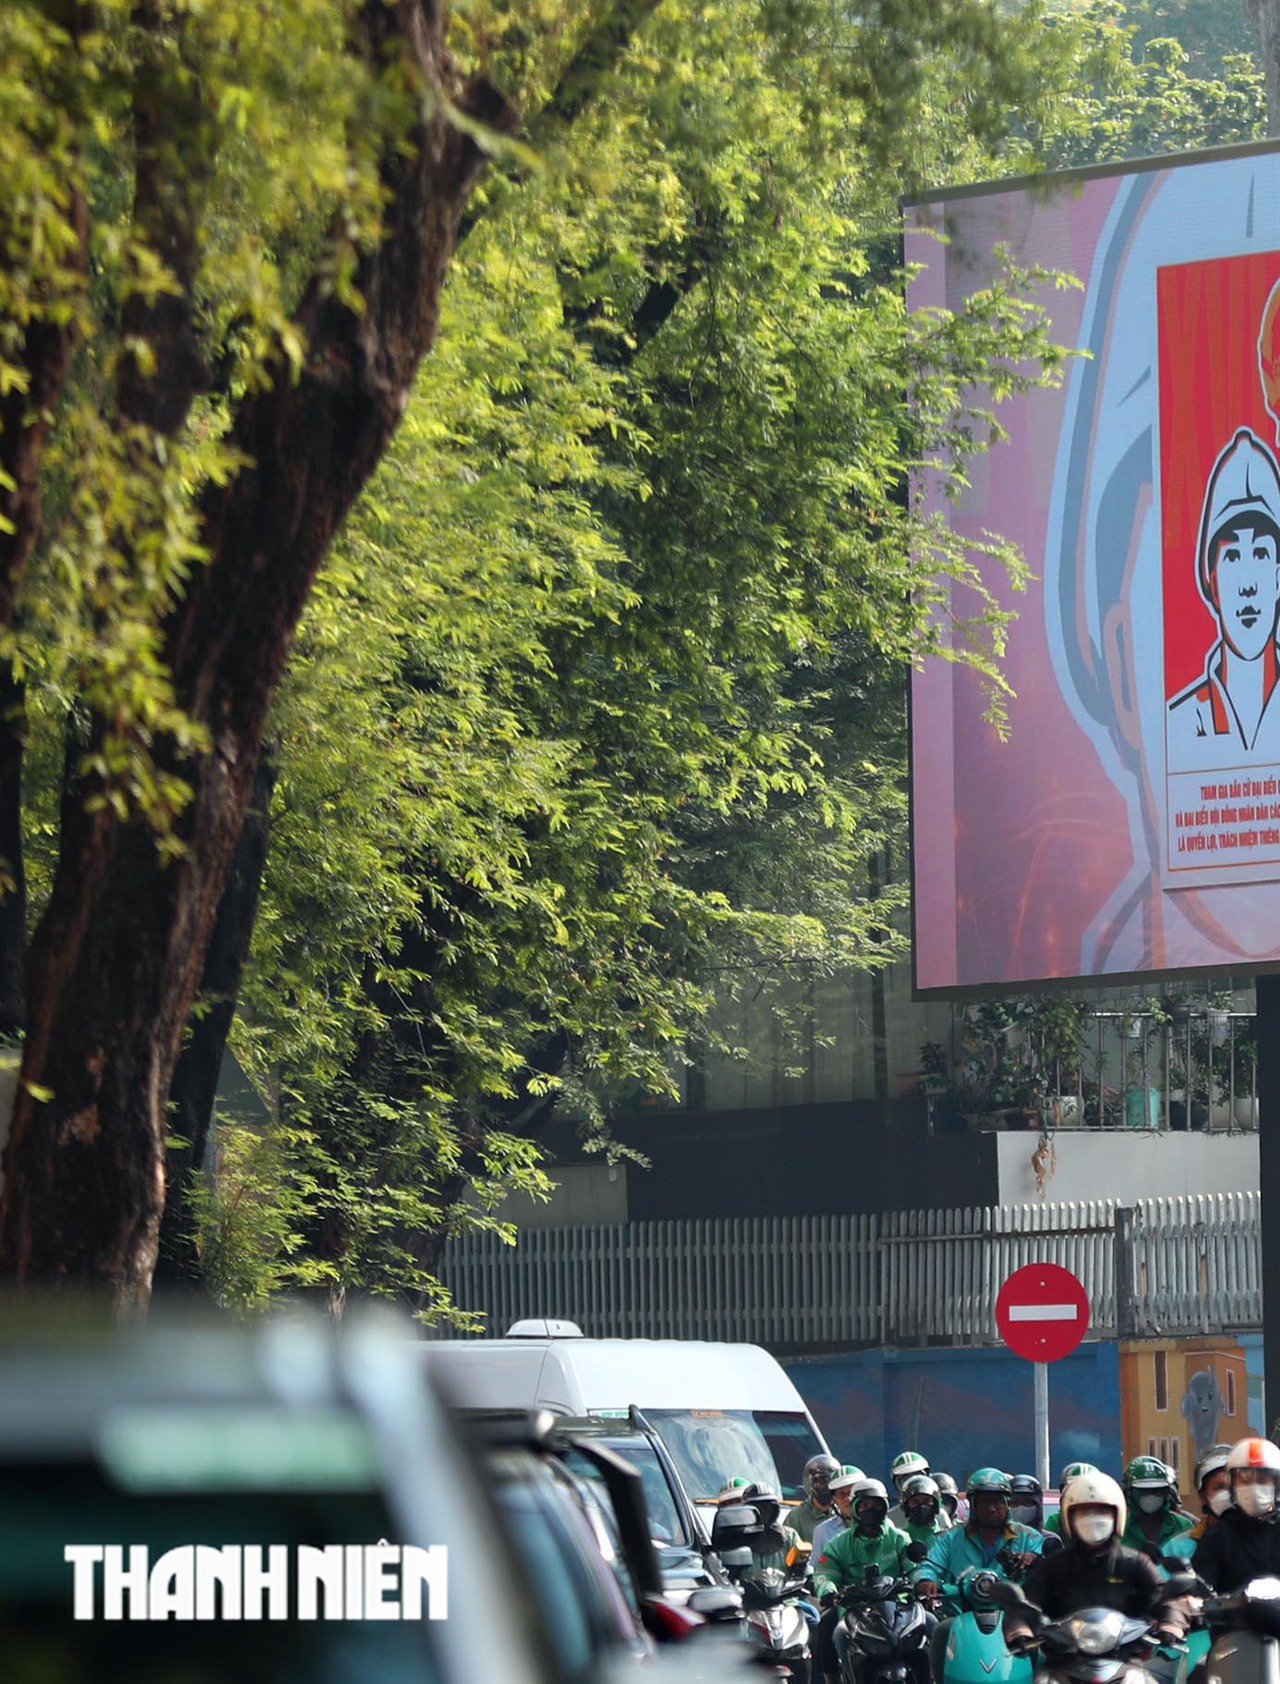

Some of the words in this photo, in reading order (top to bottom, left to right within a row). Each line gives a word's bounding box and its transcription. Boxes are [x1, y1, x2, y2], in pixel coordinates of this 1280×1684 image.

[1200, 785, 1217, 800] THAM
[1218, 784, 1228, 799] GIA
[1219, 831, 1237, 848] TRÁCH
